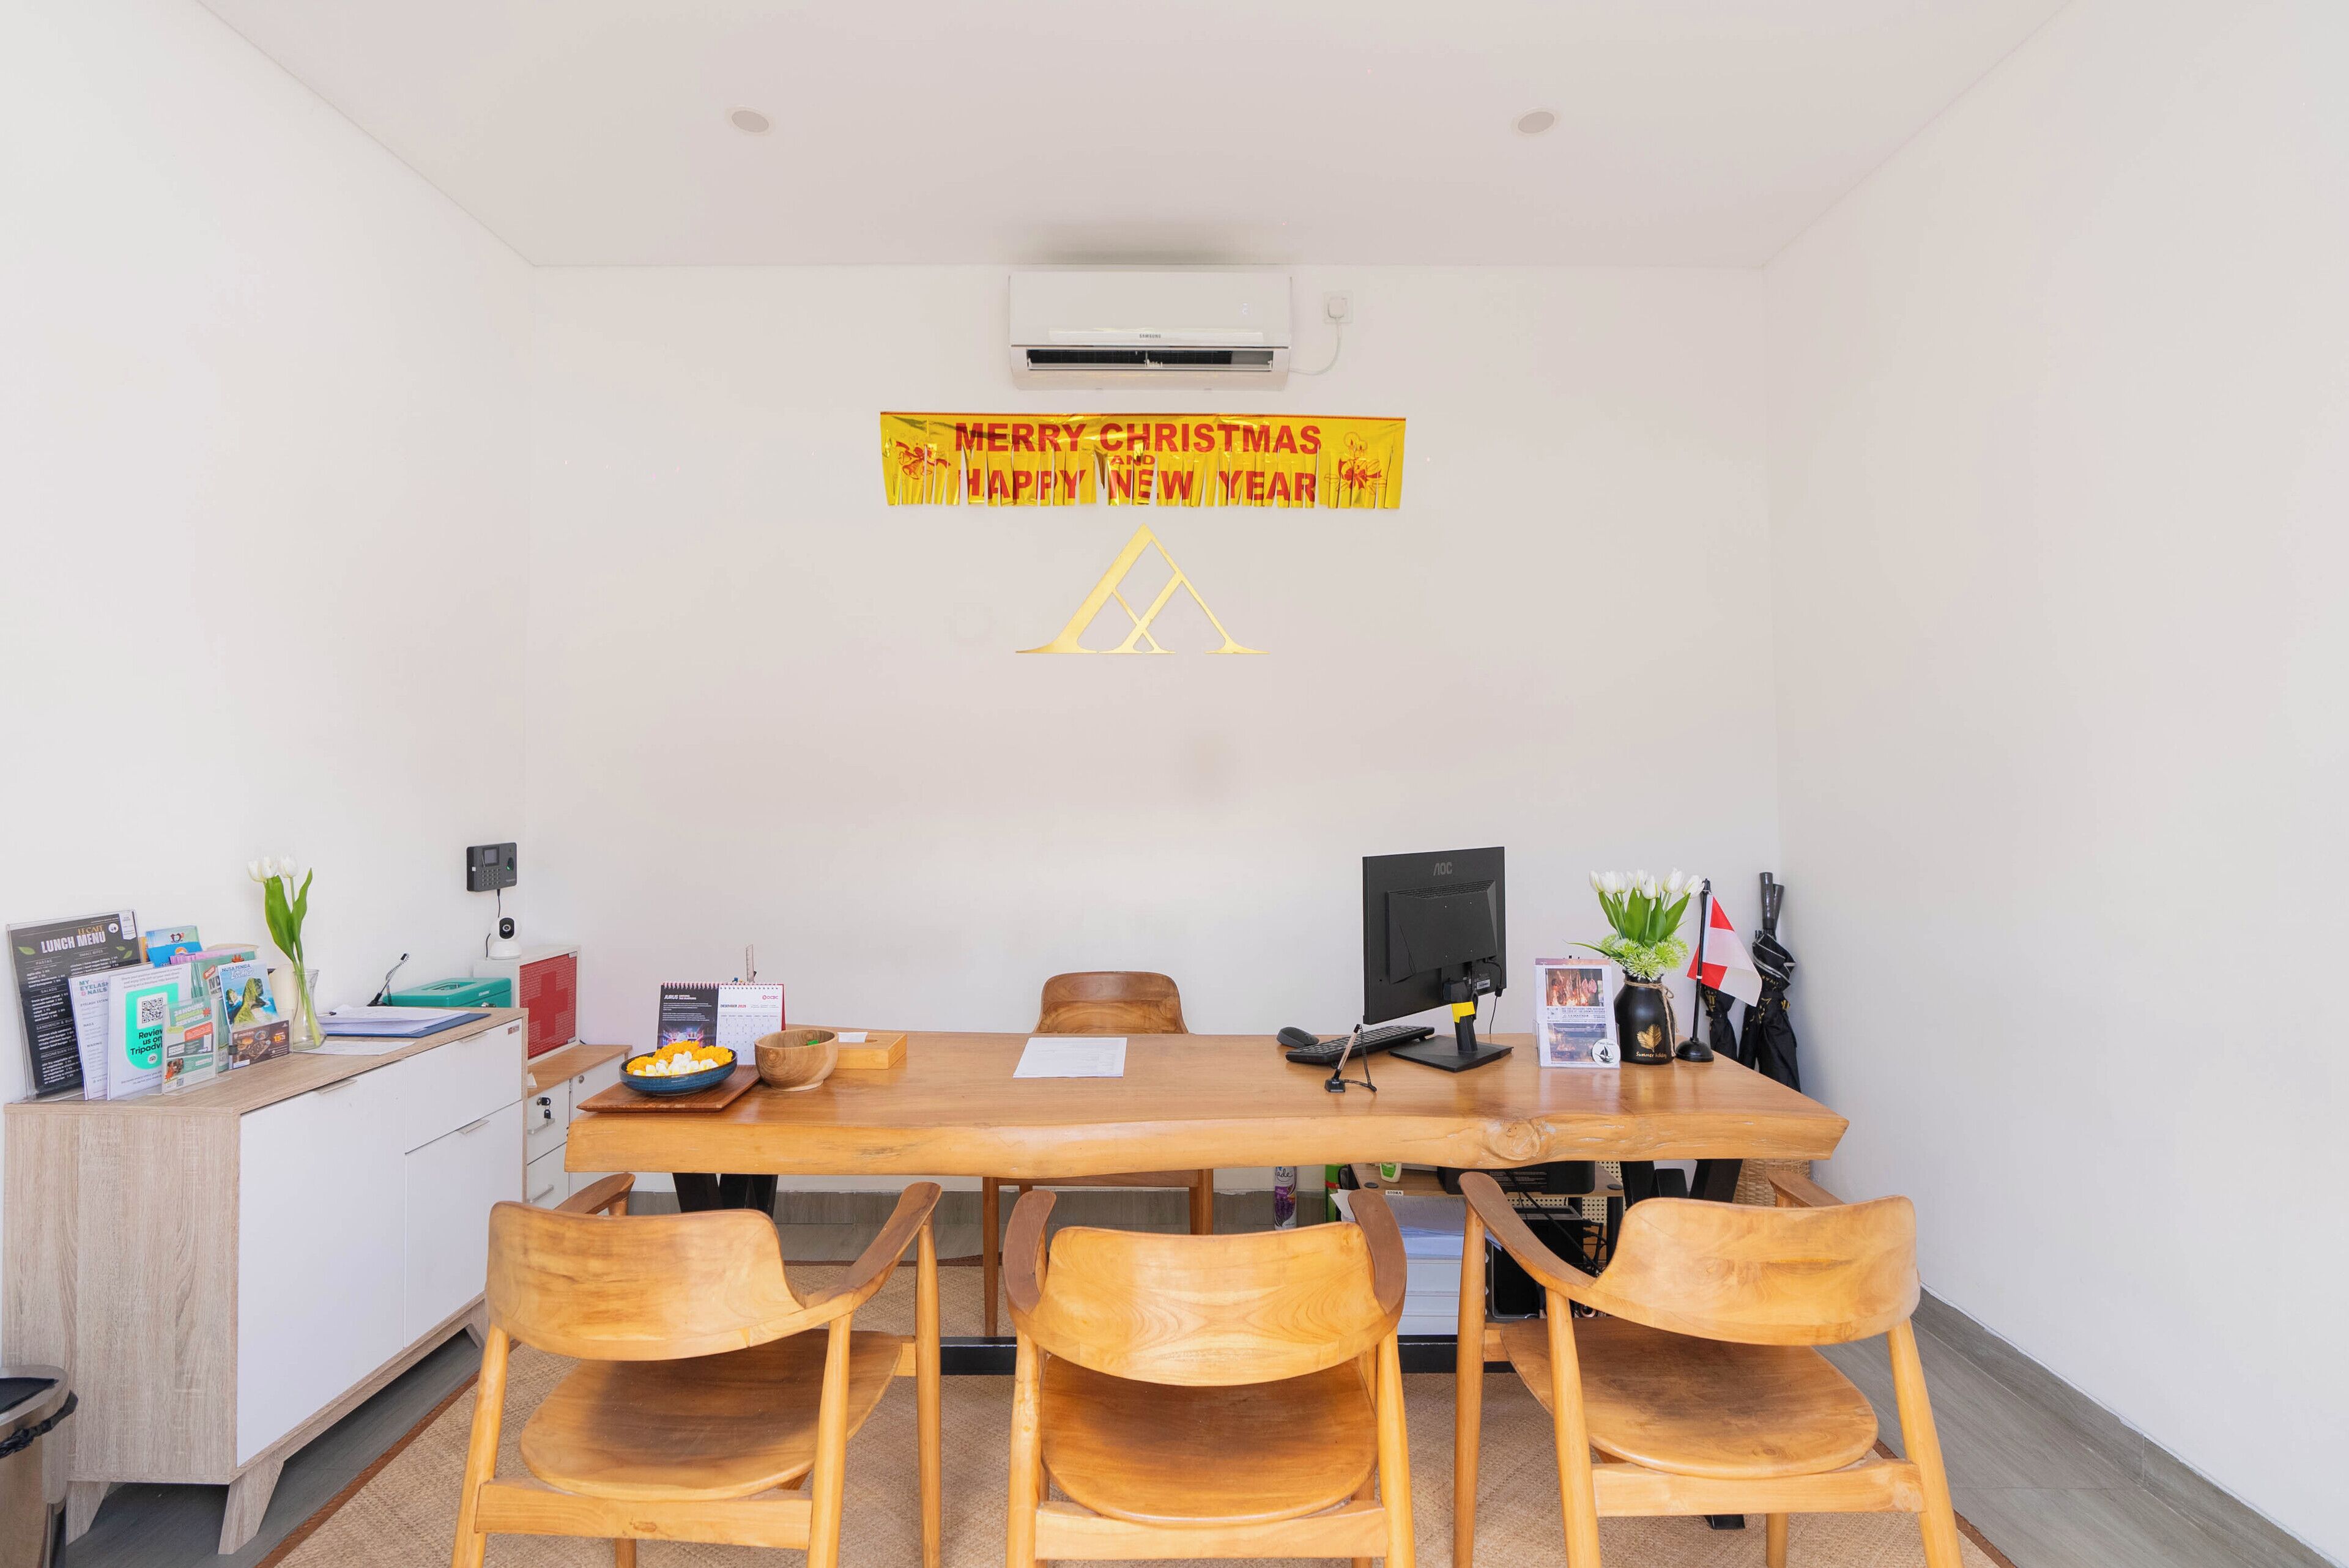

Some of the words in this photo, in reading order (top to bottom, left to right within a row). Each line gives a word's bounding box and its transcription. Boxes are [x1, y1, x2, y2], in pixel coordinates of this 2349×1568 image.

[956, 423, 1086, 451] MERRY
[1100, 423, 1321, 454] CHRISTMAS
[1110, 454, 1156, 466] AND
[958, 468, 1086, 500] HAPPY
[1109, 469, 1193, 500] NEW
[1219, 470, 1316, 502] YEAR
[1433, 862, 1452, 876] AOC
[41, 936, 75, 953] LUNCH
[76, 931, 106, 947] MENU
